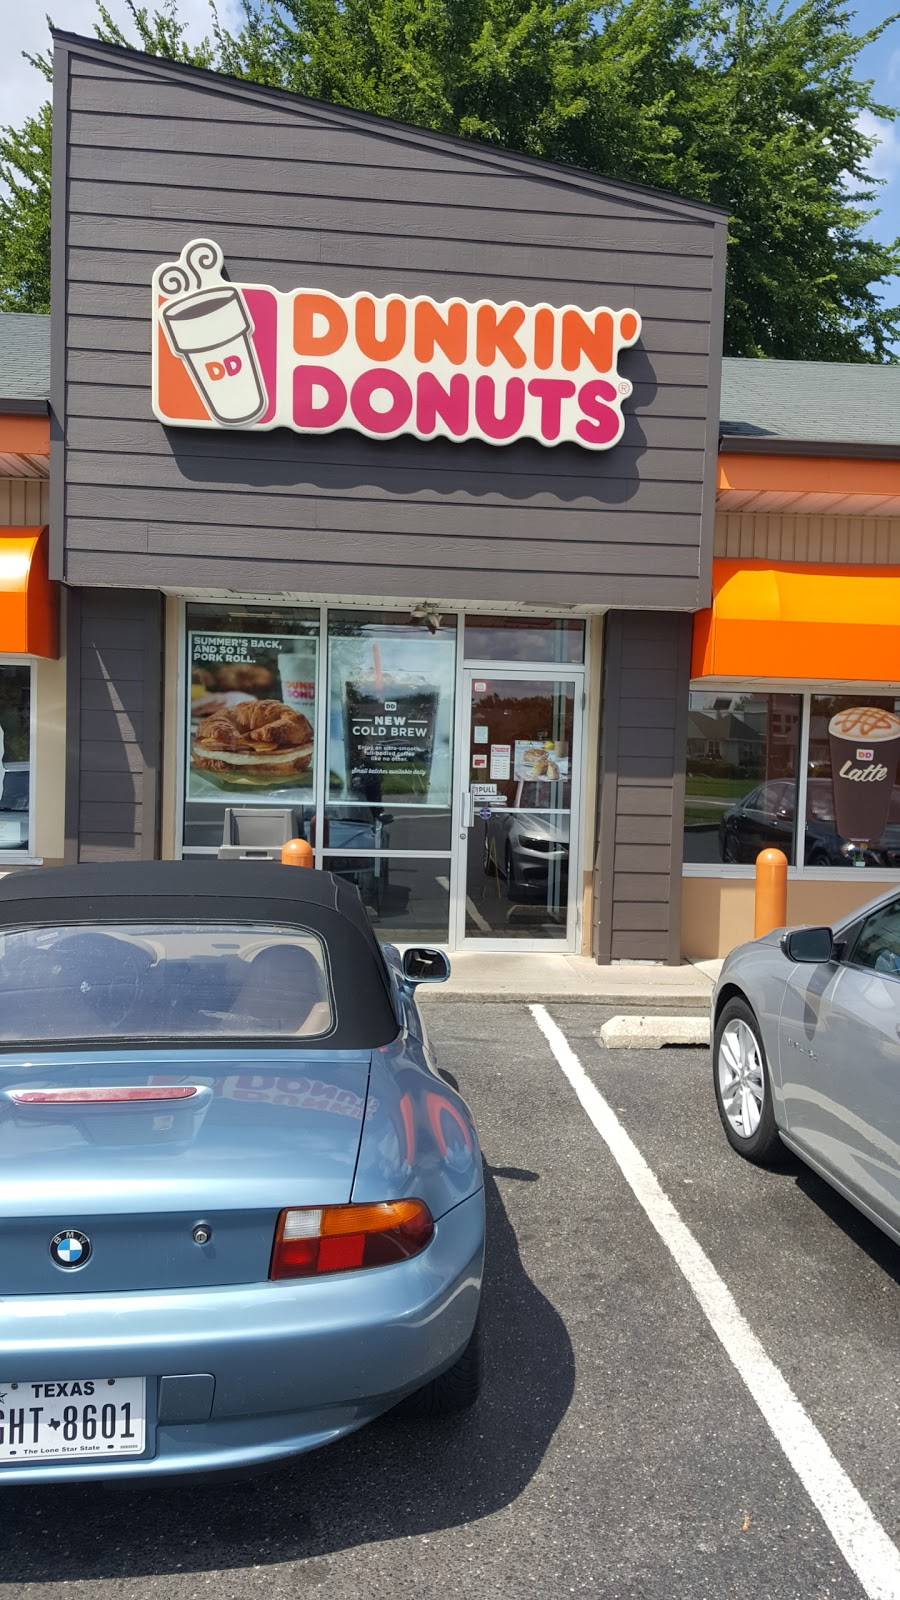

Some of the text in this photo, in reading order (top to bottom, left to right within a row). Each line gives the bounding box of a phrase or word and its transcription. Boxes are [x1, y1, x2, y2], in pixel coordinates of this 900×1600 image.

[293, 293, 637, 373] DUNKIN'
[205, 355, 242, 381] DD
[293, 365, 620, 444] DONUTS
[193, 637, 282, 650] SUMMER'S BACK,
[193, 645, 247, 655] AND SO IS
[193, 653, 256, 663] PORK ROLL.
[374, 716, 407, 726] NEW
[352, 726, 428, 737] COLD BREW
[857, 750, 872, 759] DD
[839, 760, 888, 783] Latte
[478, 785, 496, 793] PULL
[53, 1231, 88, 1245] BMW
[31, 1381, 95, 1398] TEXAS
[63, 1402, 135, 1441] 8601
